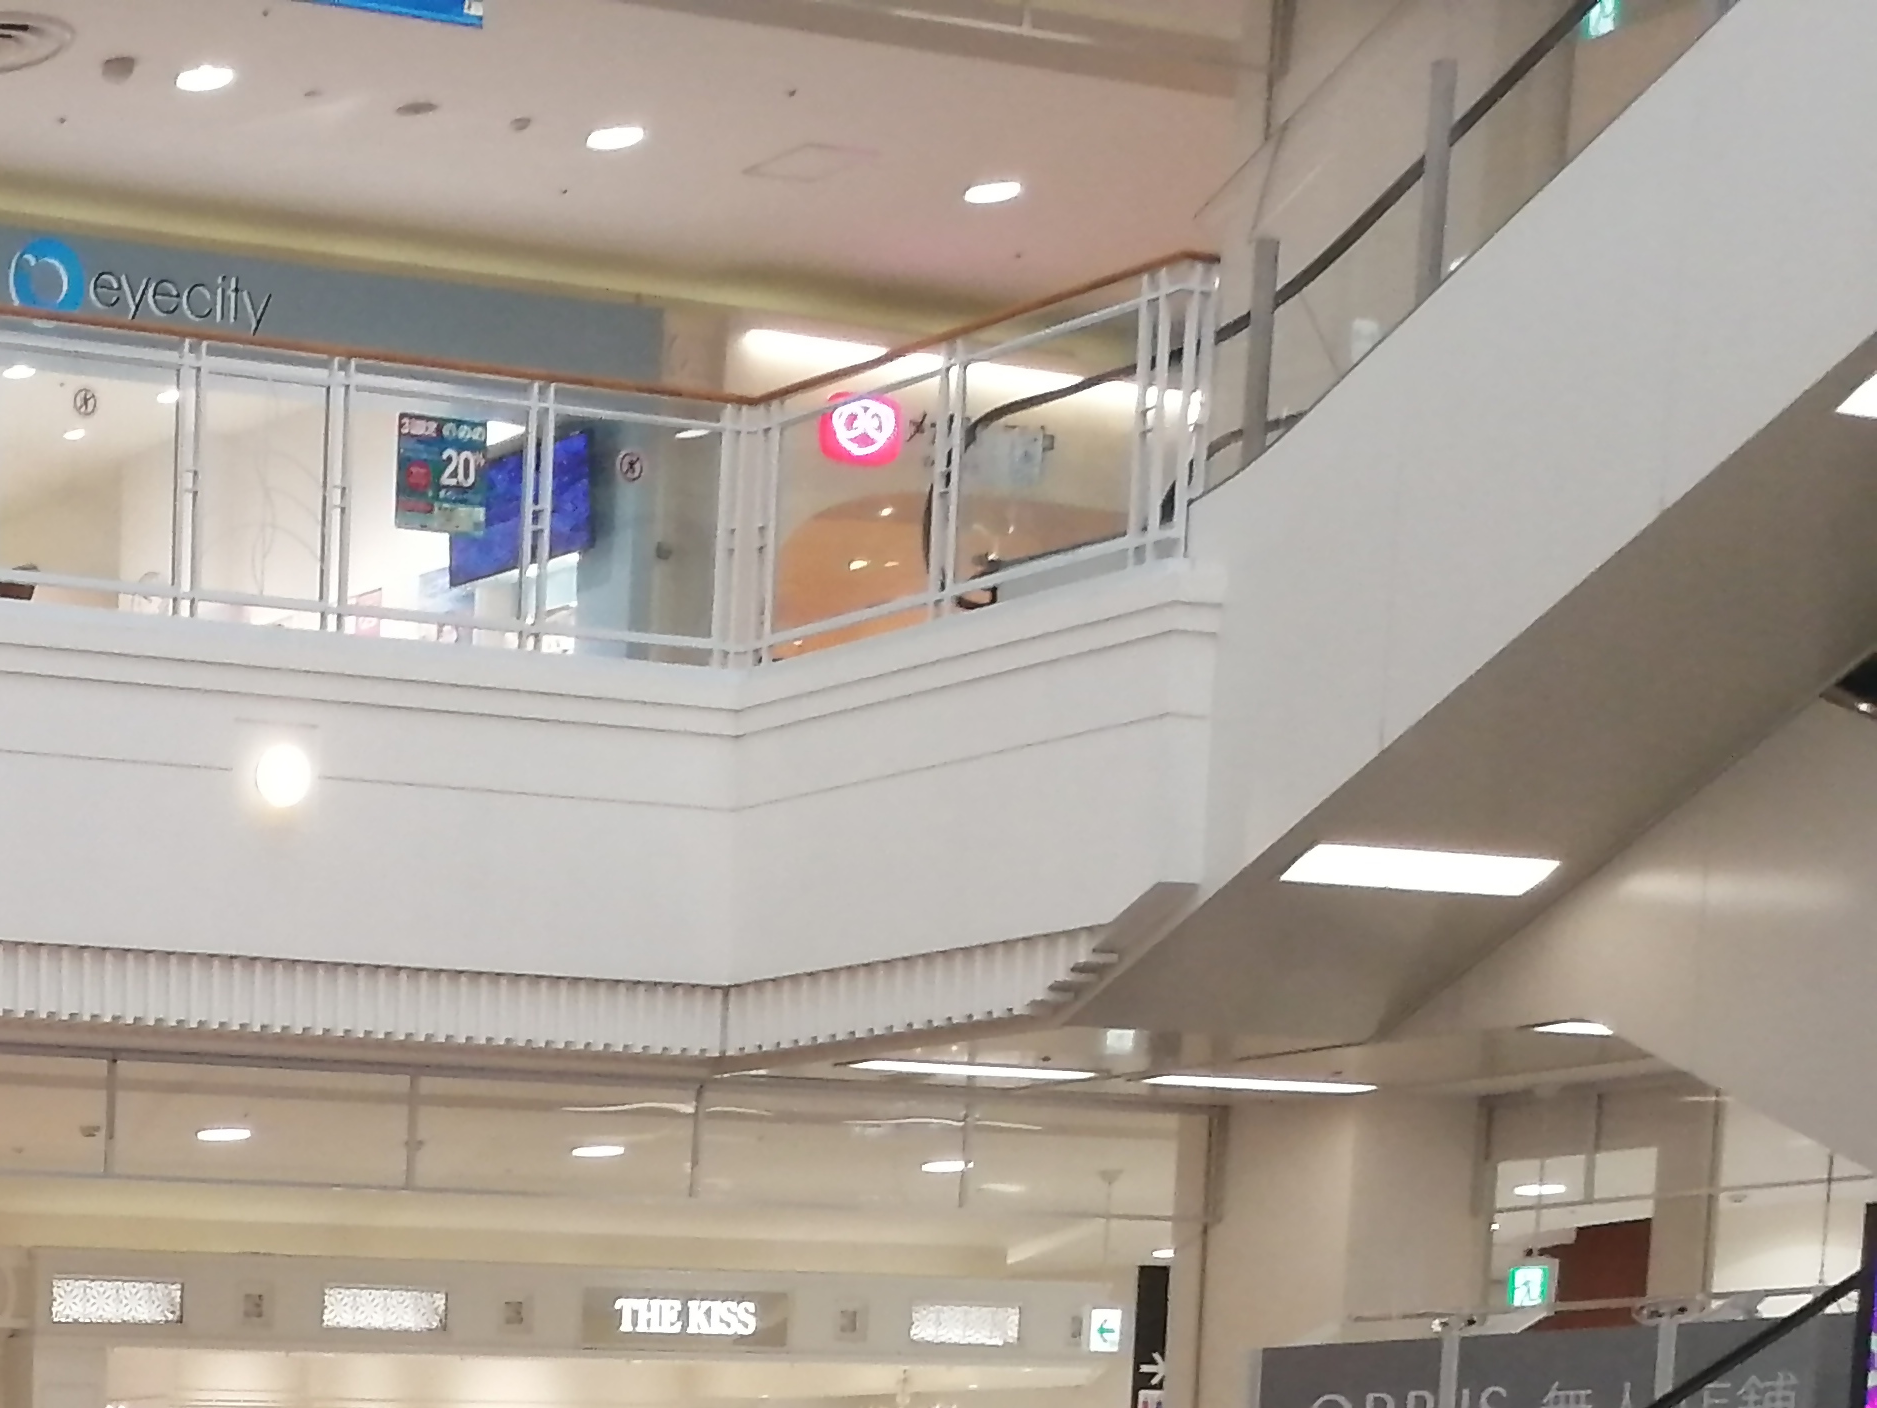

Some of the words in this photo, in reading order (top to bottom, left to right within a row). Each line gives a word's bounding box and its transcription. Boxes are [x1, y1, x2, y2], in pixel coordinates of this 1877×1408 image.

[89, 270, 272, 336] eyecity
[614, 1298, 682, 1334] THE
[686, 1300, 757, 1335] KISS
